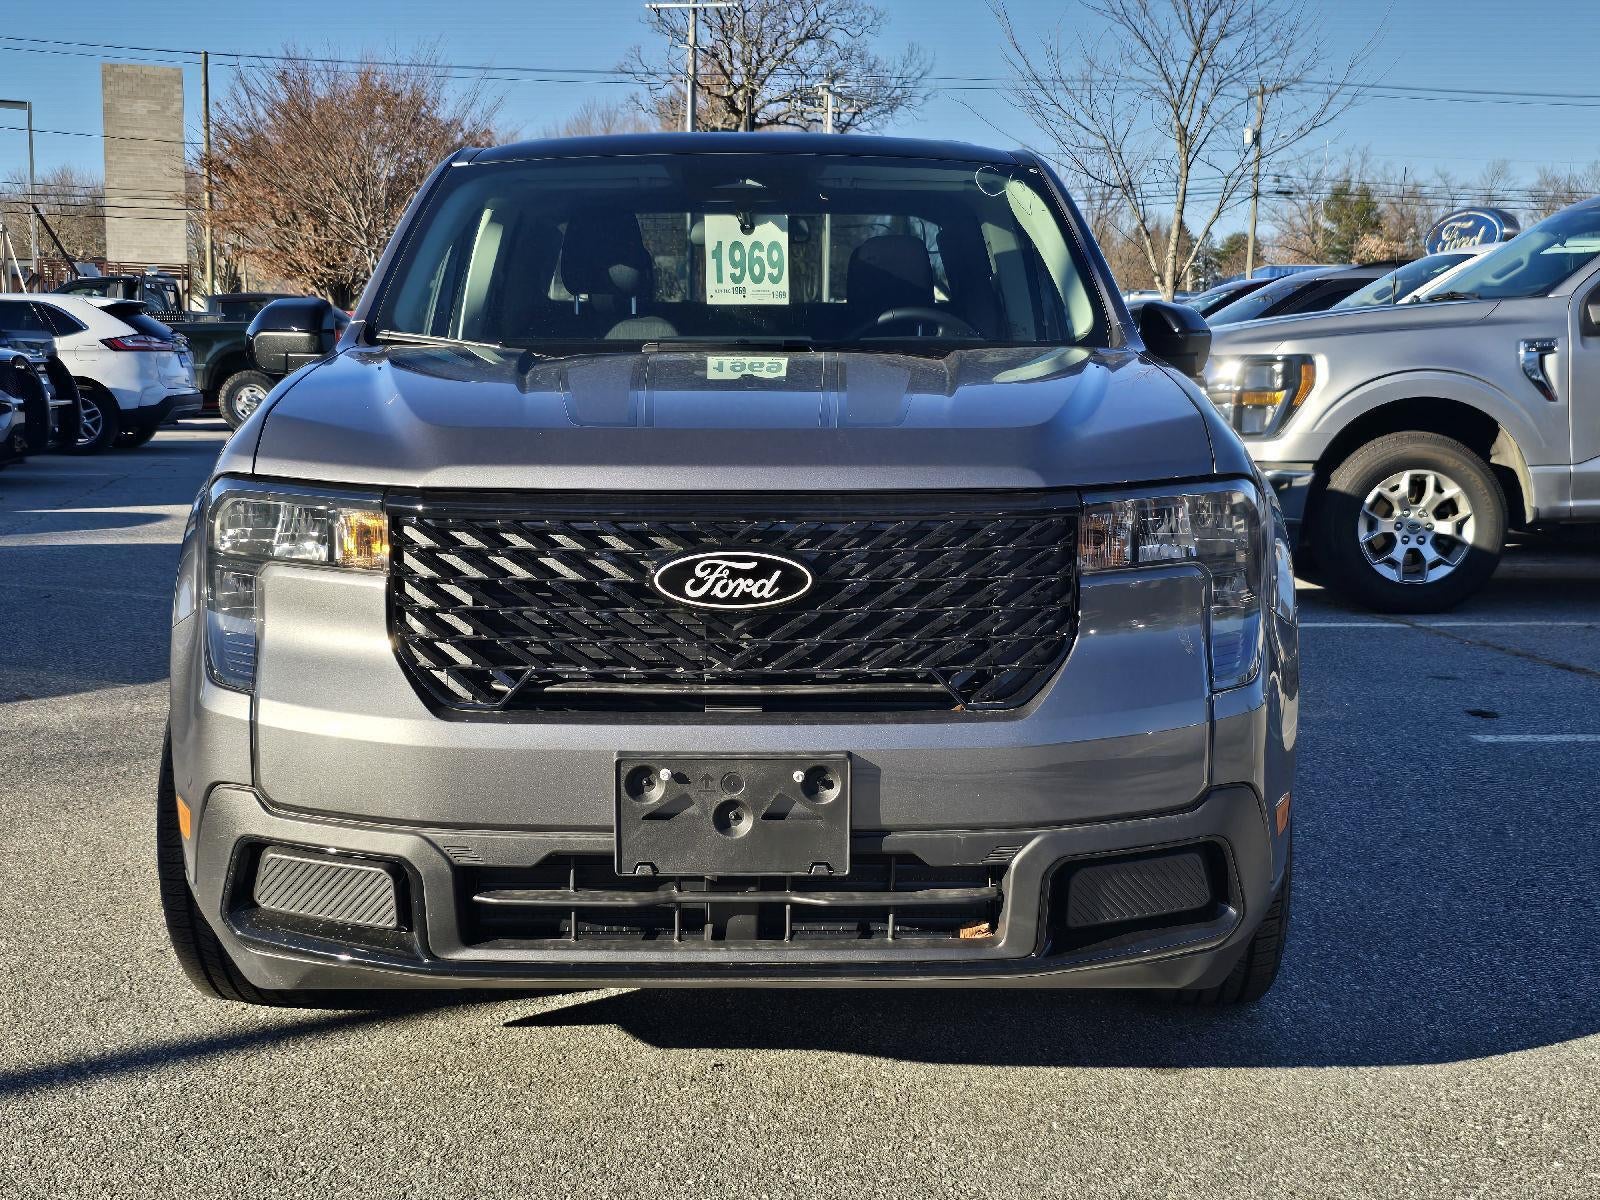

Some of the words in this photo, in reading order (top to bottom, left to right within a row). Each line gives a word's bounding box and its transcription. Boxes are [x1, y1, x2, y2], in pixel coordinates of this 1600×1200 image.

[1437, 220, 1486, 252] Ford
[712, 241, 785, 284] 1969
[732, 287, 747, 295] 1969
[772, 291, 787, 299] 1969
[685, 560, 782, 598] Ford
